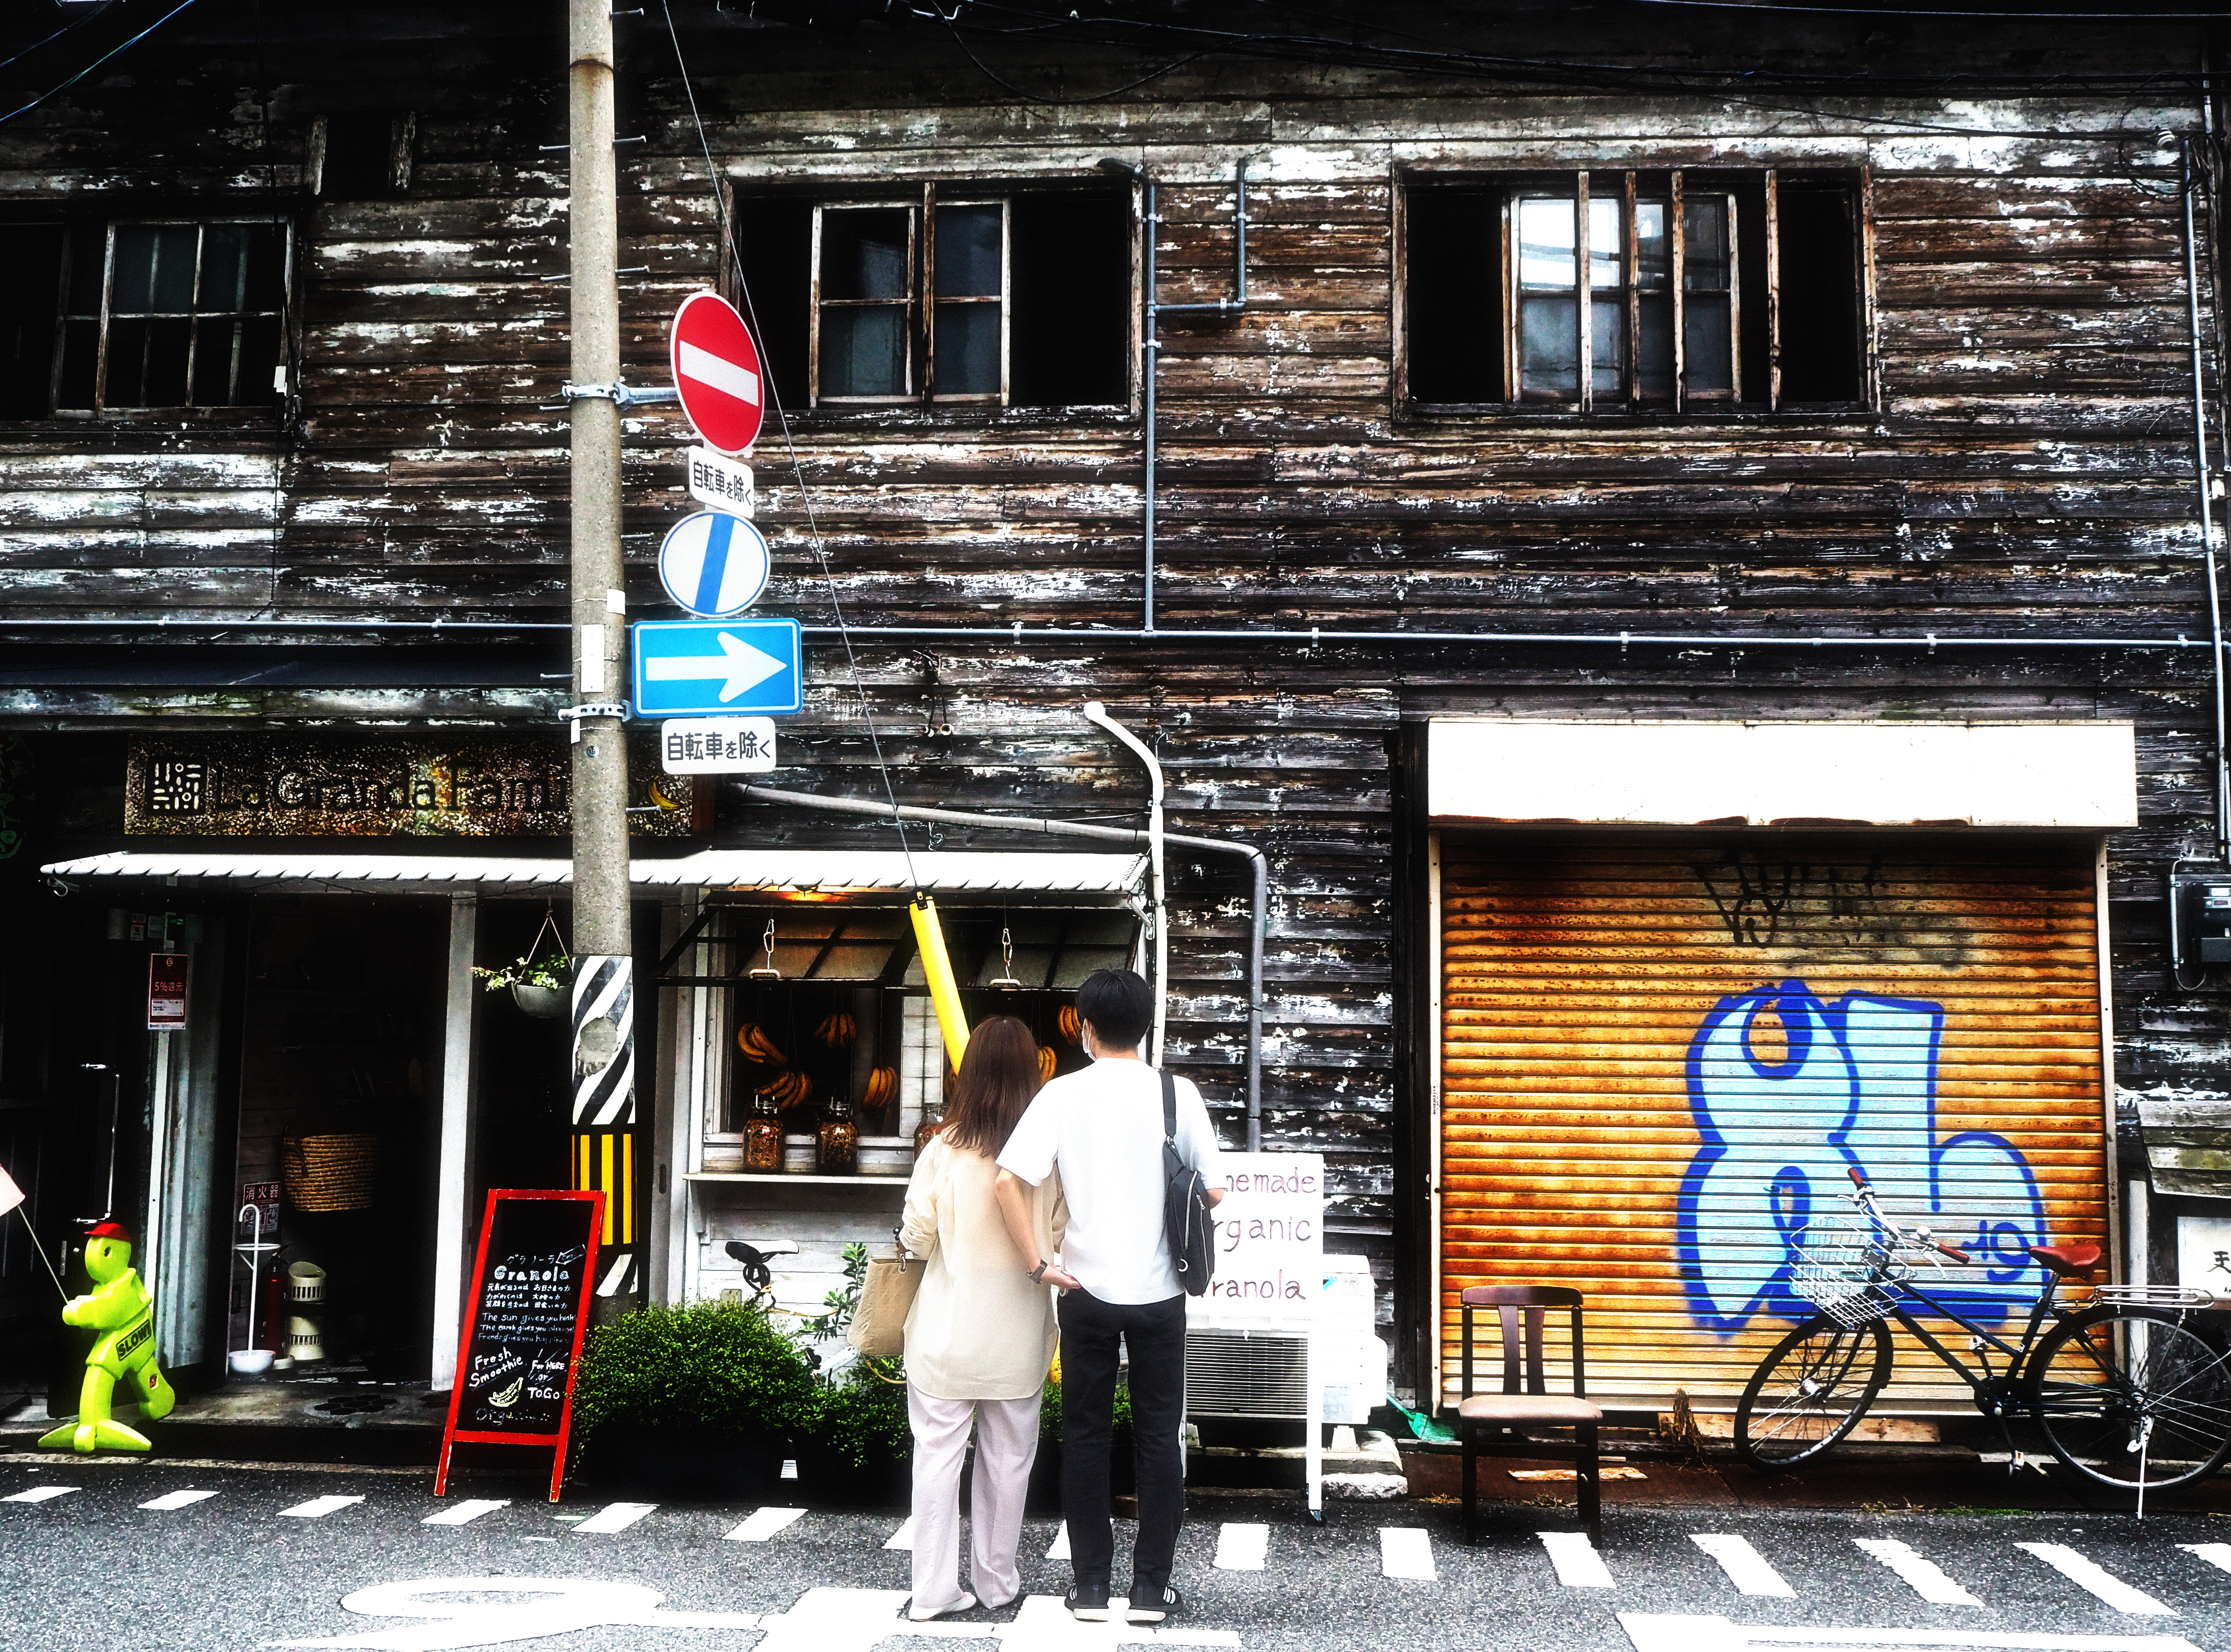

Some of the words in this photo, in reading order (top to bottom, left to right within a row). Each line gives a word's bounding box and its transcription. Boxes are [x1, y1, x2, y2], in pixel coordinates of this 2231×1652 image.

[693, 459, 752, 506] 自転車を除く
[667, 731, 771, 760] 自転車を除く
[276, 764, 436, 810] Granda
[451, 762, 641, 811] Fami
[154, 981, 183, 992] 5%還元
[246, 1184, 279, 1200] 消火器
[1212, 1217, 1311, 1252] rganic
[494, 1265, 570, 1282] Granola
[1212, 1269, 1306, 1300] ranola
[482, 1312, 498, 1322] The
[520, 1315, 545, 1324] gives
[516, 1325, 535, 1334] gives
[475, 1345, 512, 1370] Fresh
[469, 1356, 523, 1387] Smoothie
